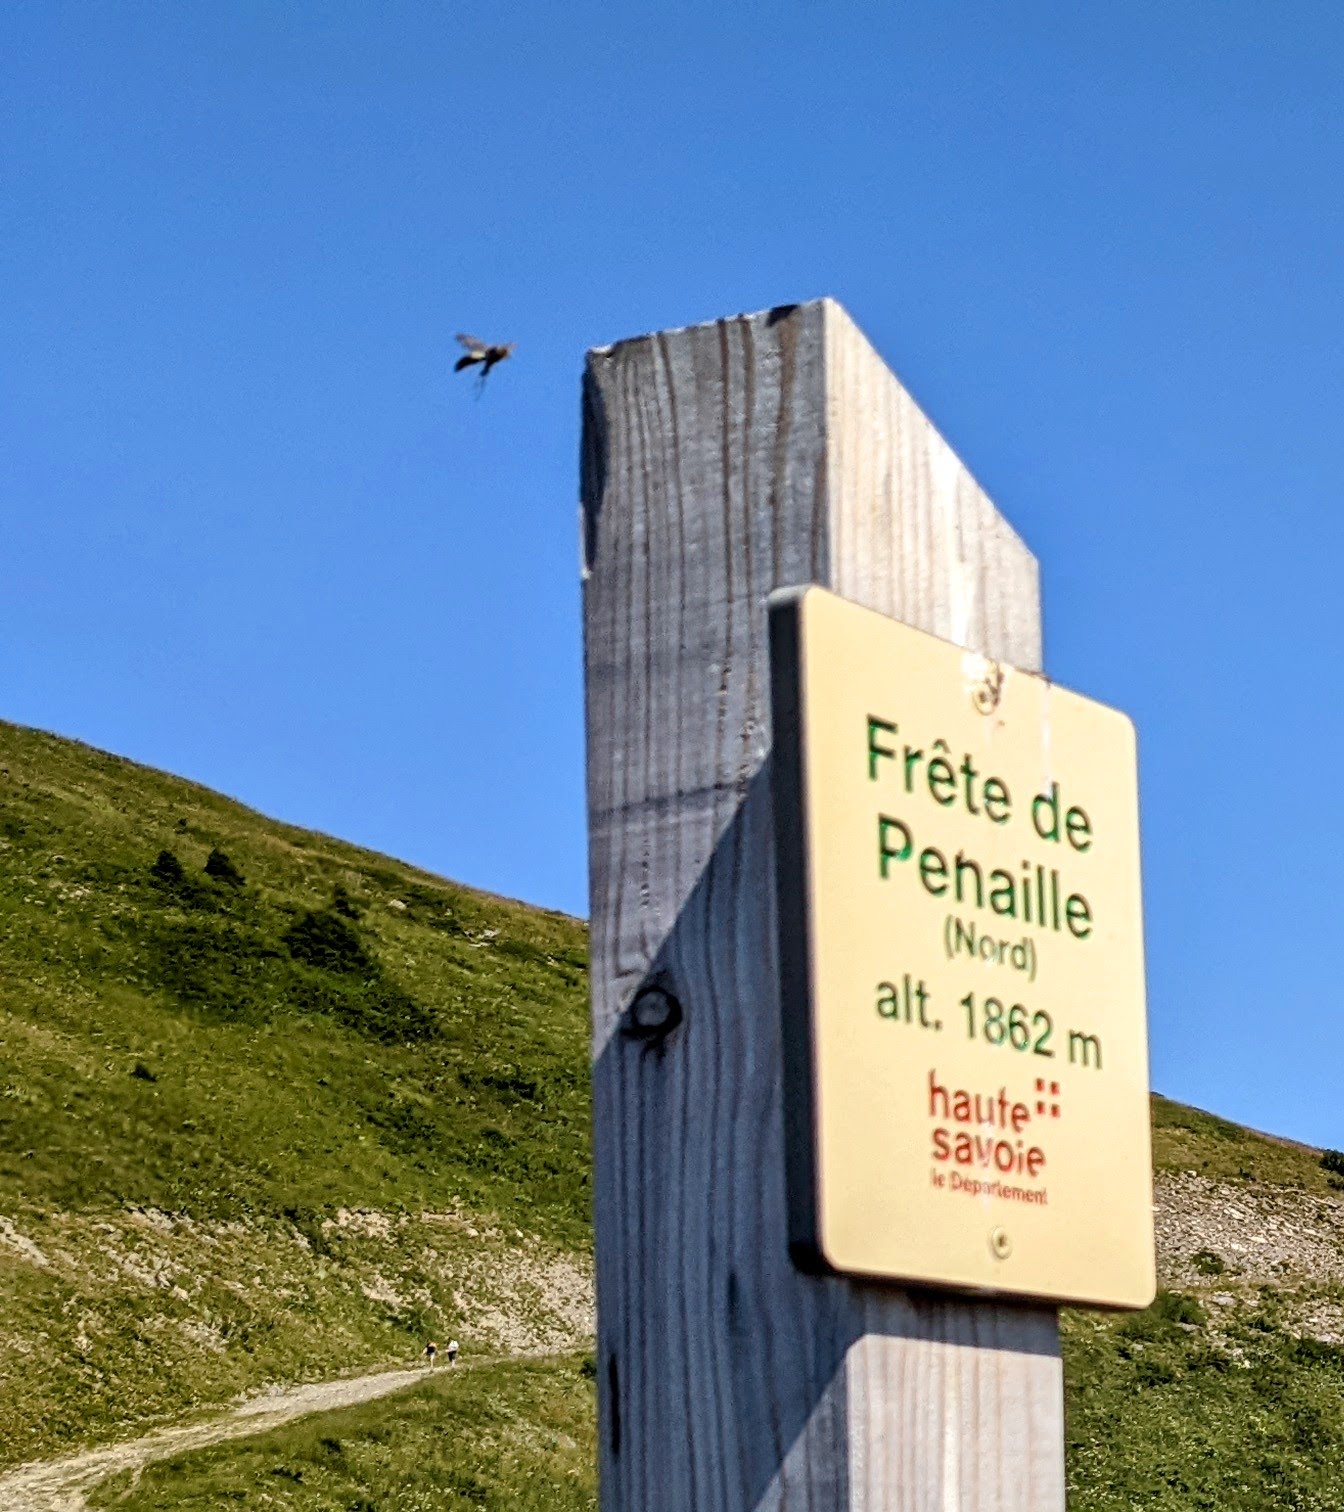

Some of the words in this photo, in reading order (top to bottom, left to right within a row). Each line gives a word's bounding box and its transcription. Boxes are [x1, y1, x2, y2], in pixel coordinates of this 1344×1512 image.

[865, 713, 1012, 825] Frête
[1031, 783, 1093, 853] de
[876, 814, 1093, 940] Penaille
[944, 913, 1038, 983] (Nord)
[875, 976, 941, 1031] alt.
[961, 990, 1055, 1059] 1862
[1069, 1029, 1103, 1071] m
[928, 1068, 1030, 1133] haute
[932, 1127, 1046, 1177] savoie
